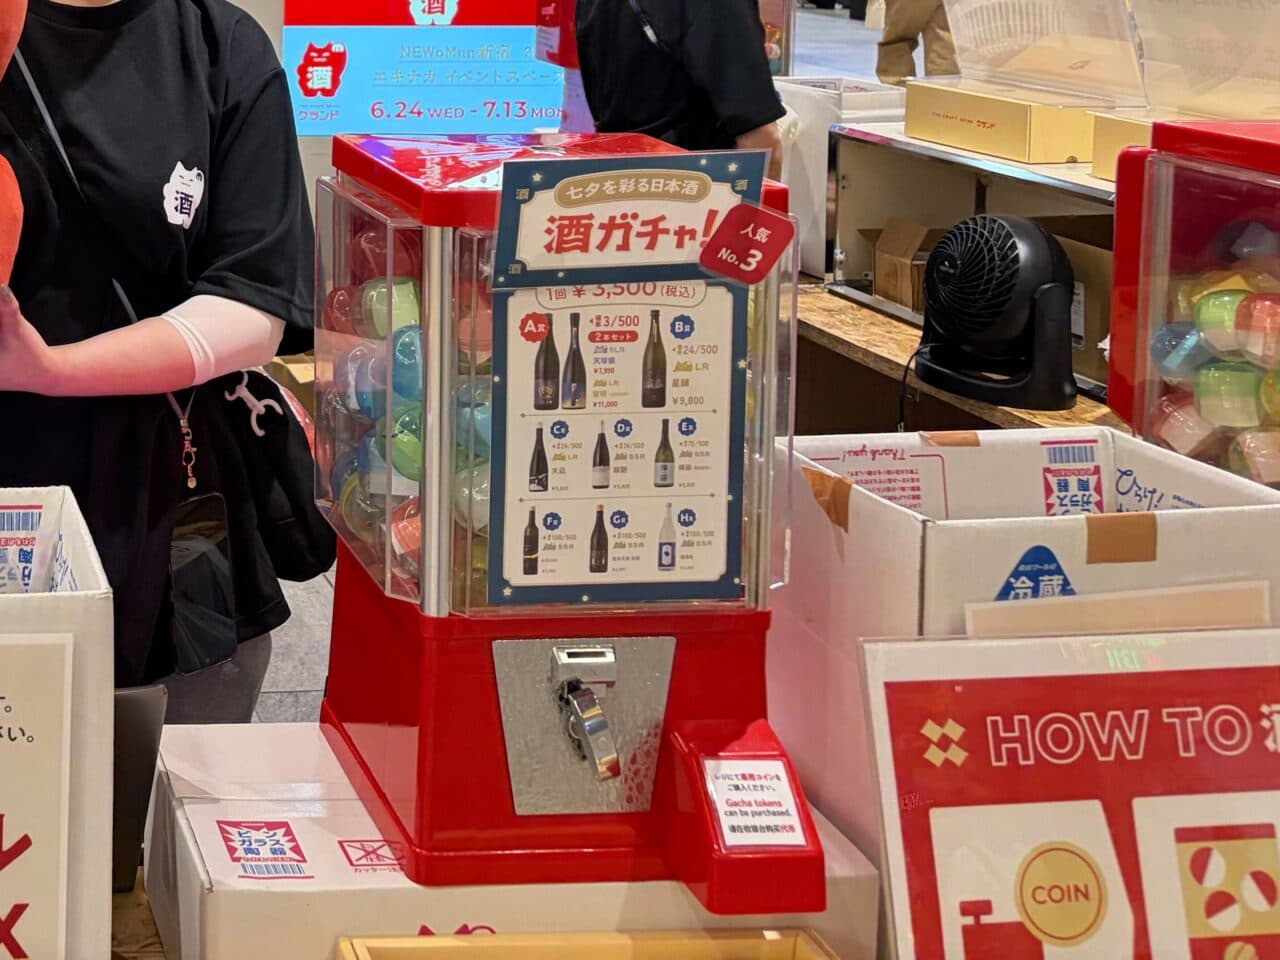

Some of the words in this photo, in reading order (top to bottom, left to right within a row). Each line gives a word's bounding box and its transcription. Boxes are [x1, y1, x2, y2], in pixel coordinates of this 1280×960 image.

[306, 66, 333, 90] 酒
[370, 101, 424, 119] 6.24
[428, 106, 465, 119] WED
[482, 101, 528, 119] 7.13
[565, 178, 700, 200] 七夕を彩る日本酒
[174, 190, 194, 218] 酒
[544, 208, 719, 255] 酒ガチャ!
[740, 223, 772, 243] 人気
[717, 247, 764, 272] No.3
[1056, 493, 1093, 508] ガラス
[1009, 575, 1065, 600] 冷蔵
[985, 709, 1150, 767] HOW
[1162, 704, 1252, 758] TO
[724, 809, 738, 817] can
[740, 809, 750, 817] be
[751, 808, 792, 818] purchased.
[725, 798, 753, 808] Gacha
[754, 798, 783, 808] tokens
[237, 830, 278, 839] ビン
[239, 838, 285, 847] ガラス
[1031, 884, 1090, 906] COIN
